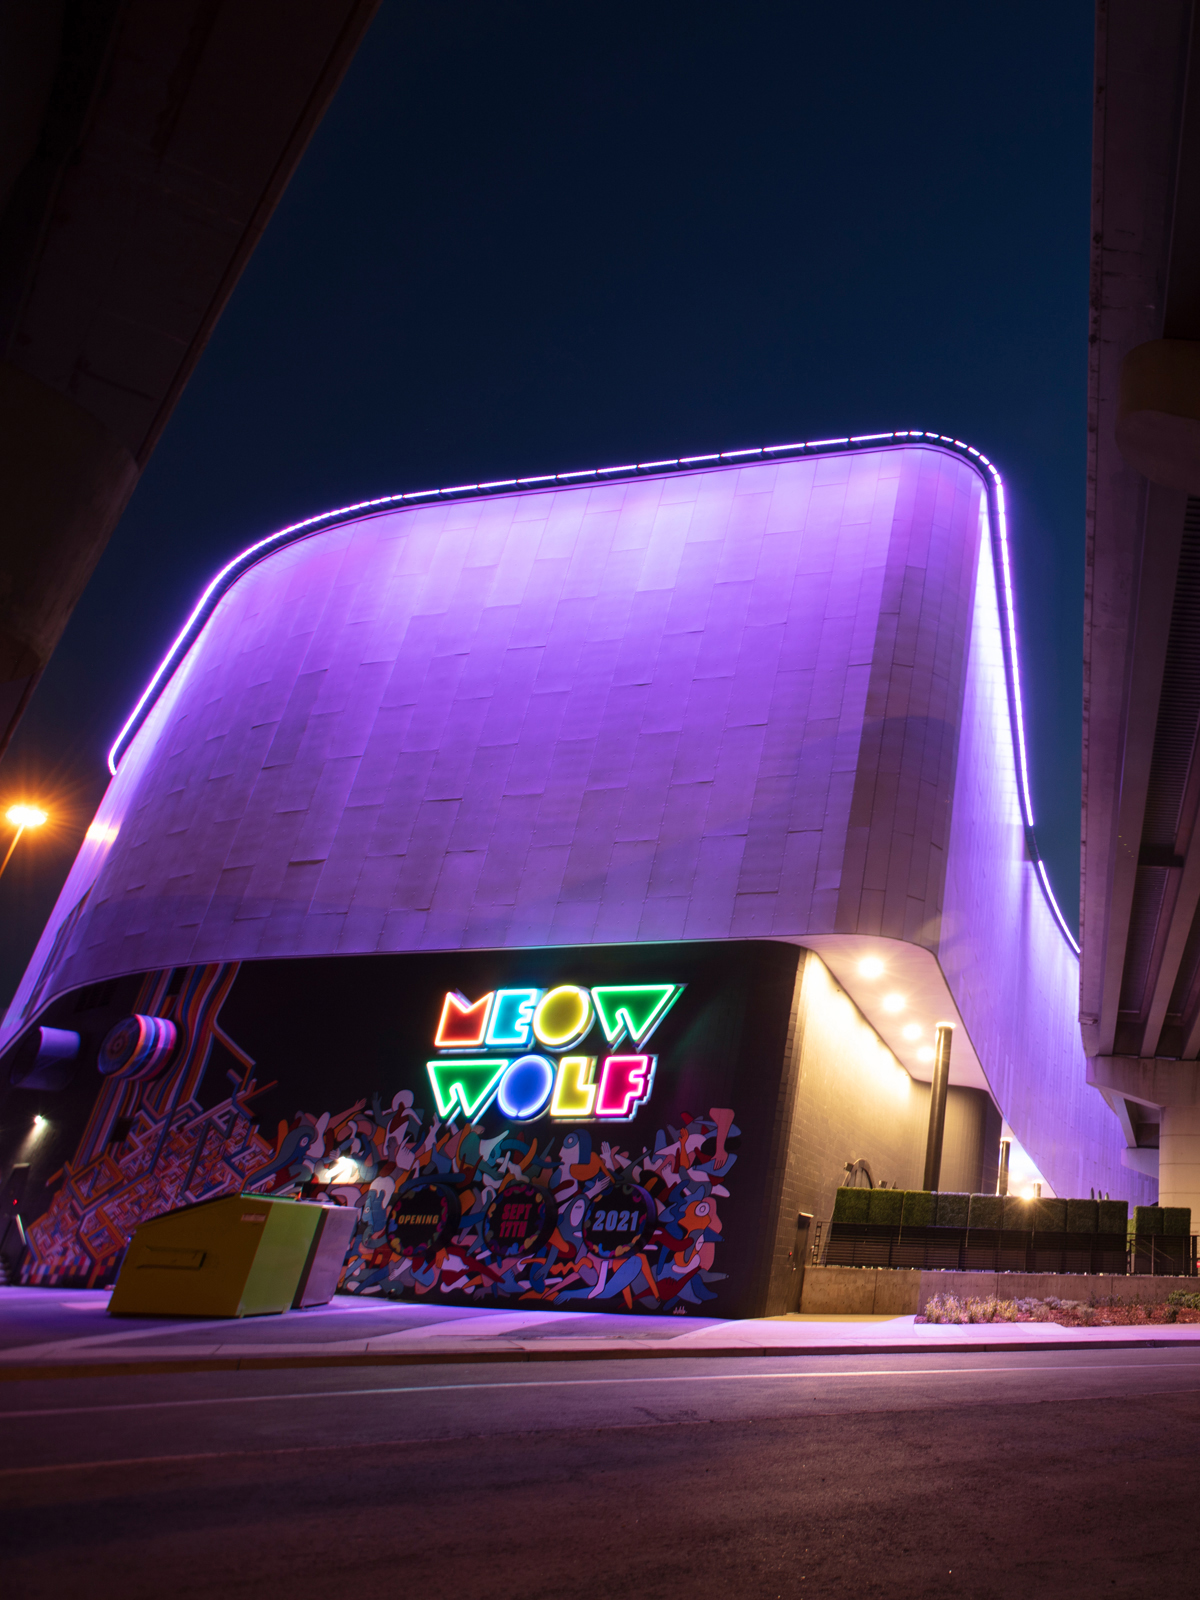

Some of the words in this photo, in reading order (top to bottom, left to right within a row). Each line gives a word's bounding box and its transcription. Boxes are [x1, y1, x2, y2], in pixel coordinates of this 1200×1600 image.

[434, 983, 687, 1053] MEOW
[426, 1054, 658, 1125] WOLF
[397, 1214, 440, 1225] OPENING
[502, 1204, 532, 1220] SEPT
[592, 1210, 639, 1231] 2021
[499, 1221, 528, 1238] 17TH
